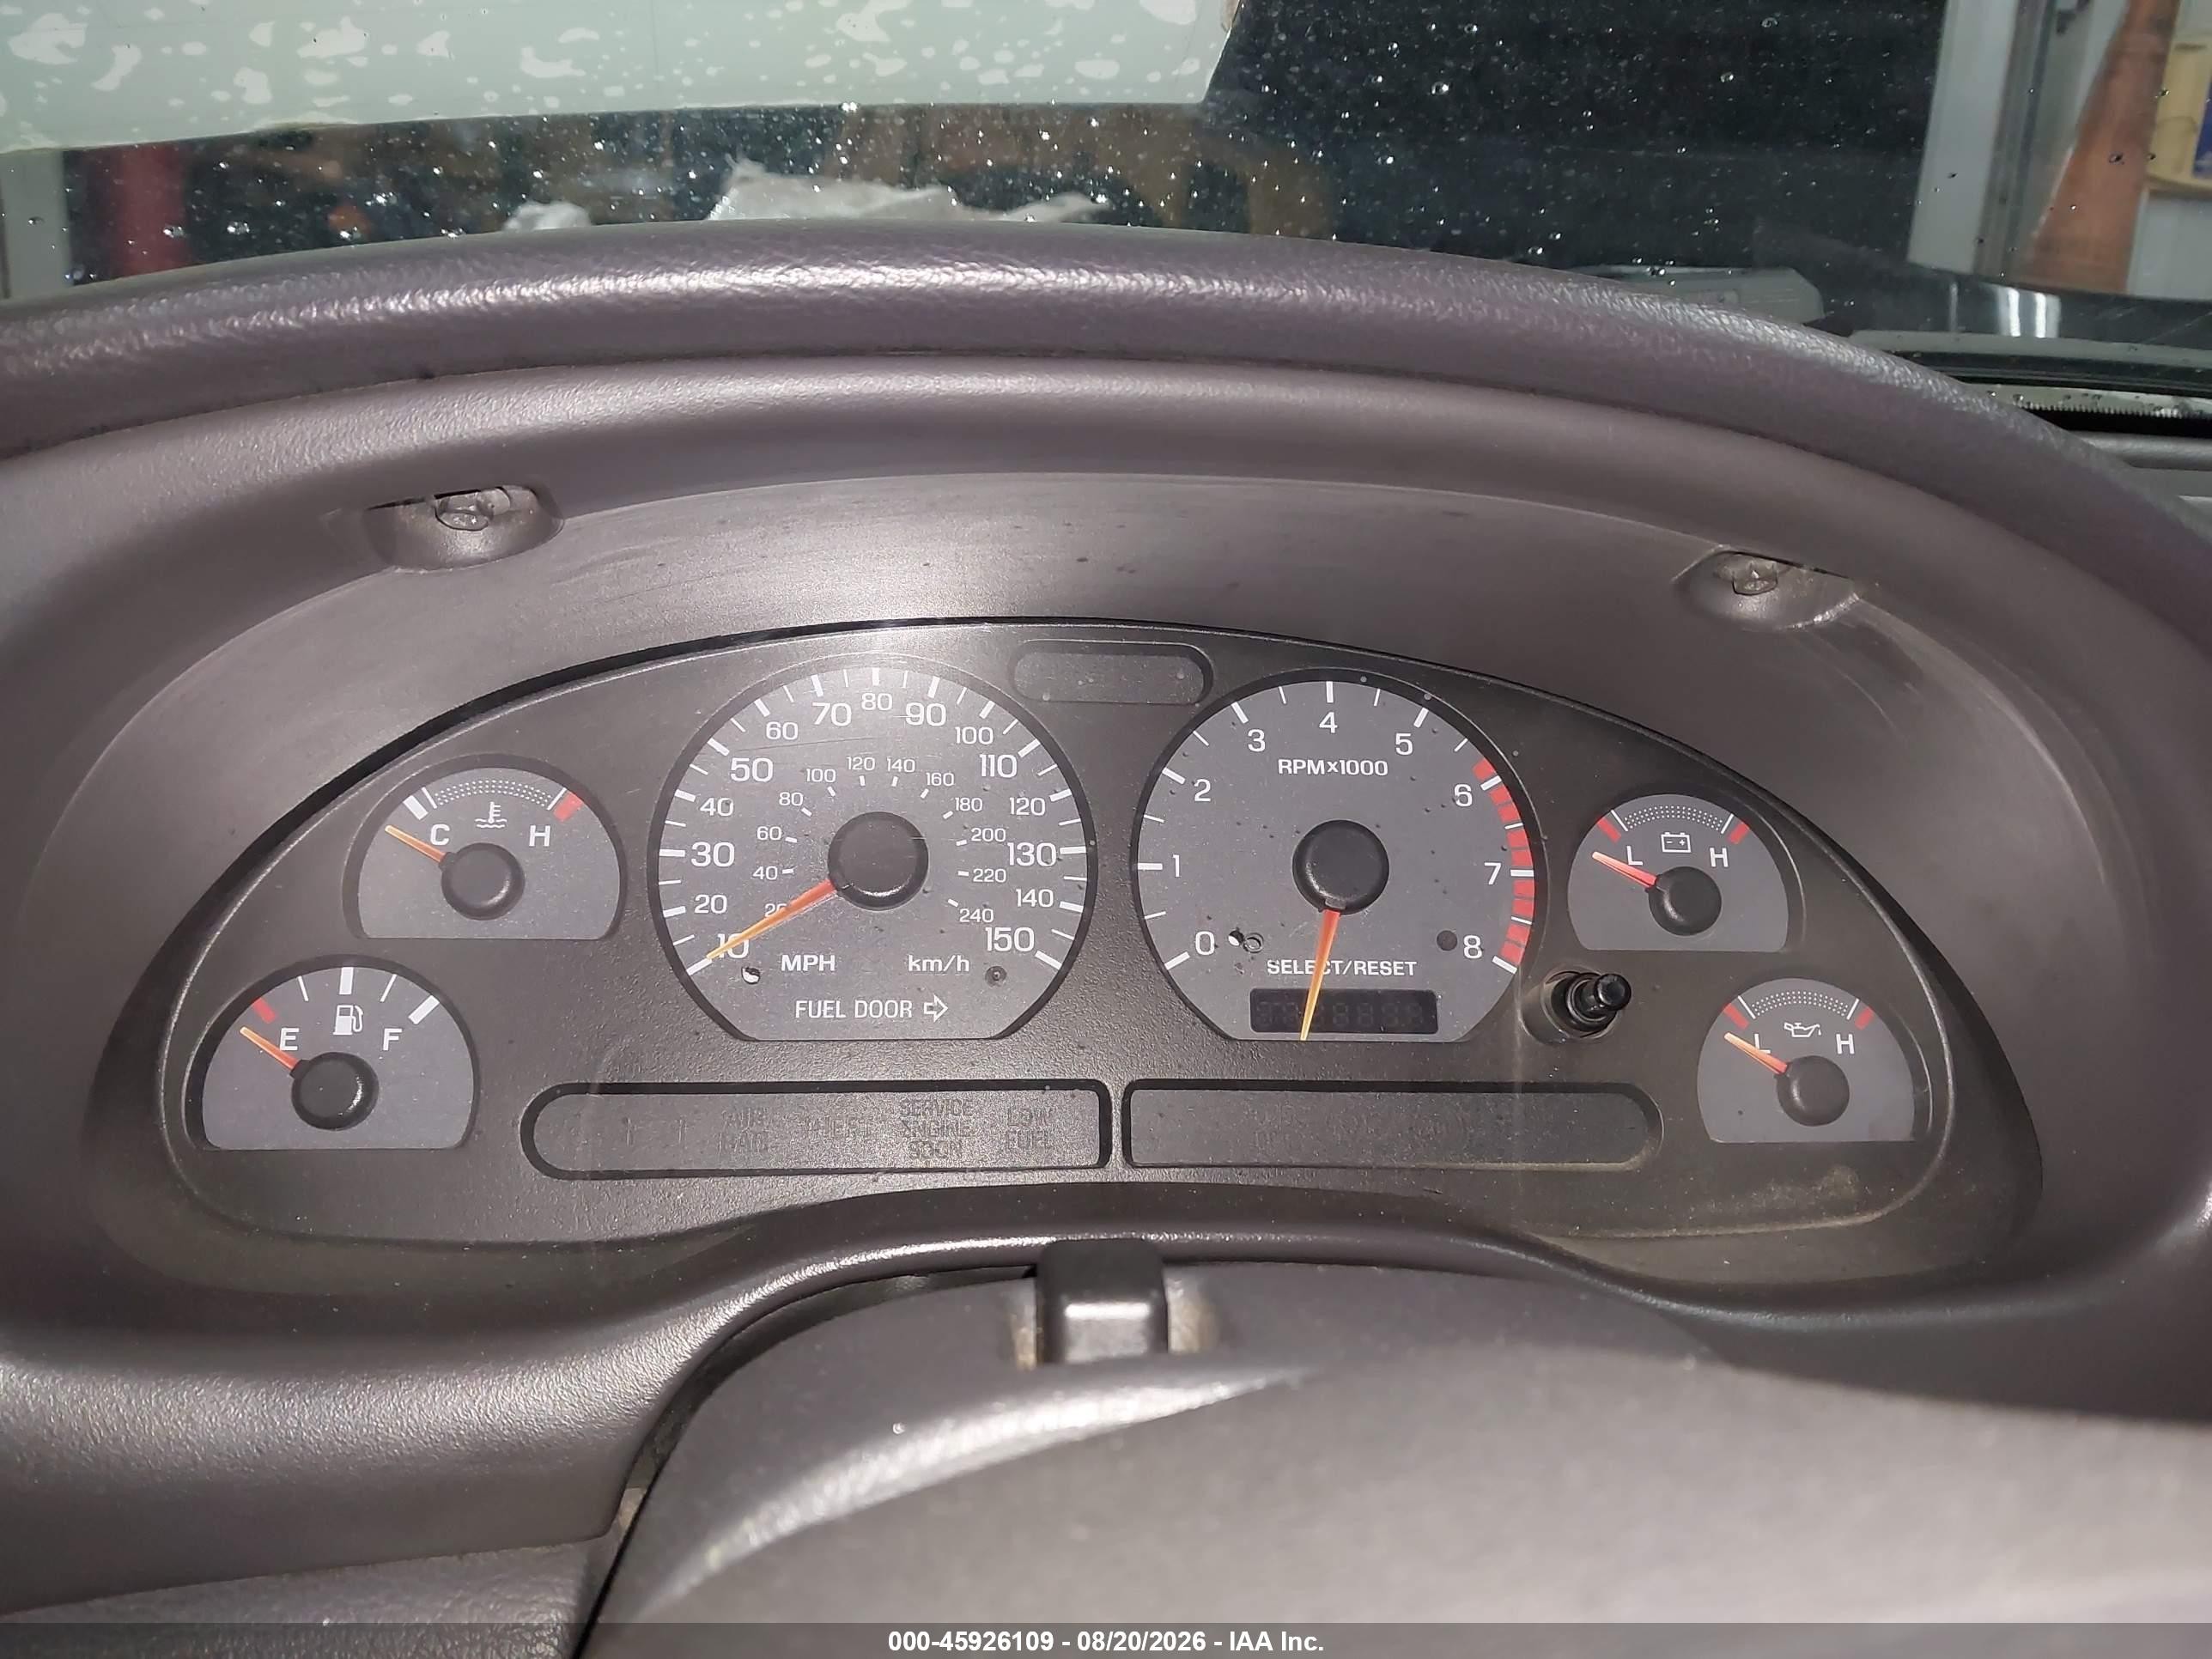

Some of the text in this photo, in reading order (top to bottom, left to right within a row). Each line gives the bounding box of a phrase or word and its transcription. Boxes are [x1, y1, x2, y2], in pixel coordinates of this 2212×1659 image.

[861, 692, 893, 711] 80
[812, 702, 852, 726] 70
[904, 702, 946, 726] 90
[1319, 711, 1338, 733] 4
[766, 721, 799, 740] 60
[954, 726, 994, 745] 100
[1248, 729, 1266, 752] 3
[1395, 732, 1413, 756] 5
[729, 757, 774, 782] 50
[847, 757, 876, 771] 120
[886, 757, 915, 773] 140
[979, 753, 1018, 778] 110
[806, 768, 836, 783] 100
[923, 772, 955, 787] 160
[779, 792, 805, 807] 80
[1194, 778, 1211, 802] 2
[1454, 783, 1473, 807] 6
[700, 797, 734, 817] 40
[954, 797, 983, 811] 180
[1009, 797, 1046, 816] 120
[429, 823, 450, 846] C
[528, 824, 551, 847] H
[757, 826, 782, 841] 60
[970, 827, 1006, 843] 200
[690, 842, 735, 867] 30
[1006, 842, 1057, 866] 130
[1626, 845, 1644, 866] L
[1709, 847, 1729, 867] H
[752, 866, 778, 880] 40
[973, 868, 1006, 883] 220
[1172, 854, 1180, 878] 1
[1484, 862, 1502, 885] 7
[694, 894, 727, 915] 20
[1015, 889, 1054, 908] 140
[763, 902, 788, 918] 2
[958, 908, 994, 923] 240
[716, 933, 750, 960] 10
[985, 927, 1036, 951] 150
[1194, 931, 1215, 956] 0
[1463, 934, 1482, 959] 8
[781, 954, 836, 971] MPH
[908, 954, 969, 972] km/h
[795, 1000, 913, 1018] FUEL DOOR
[279, 1027, 300, 1051] E
[382, 1028, 403, 1051] F
[1753, 1033, 1772, 1054] L
[1836, 1033, 1855, 1054] H
